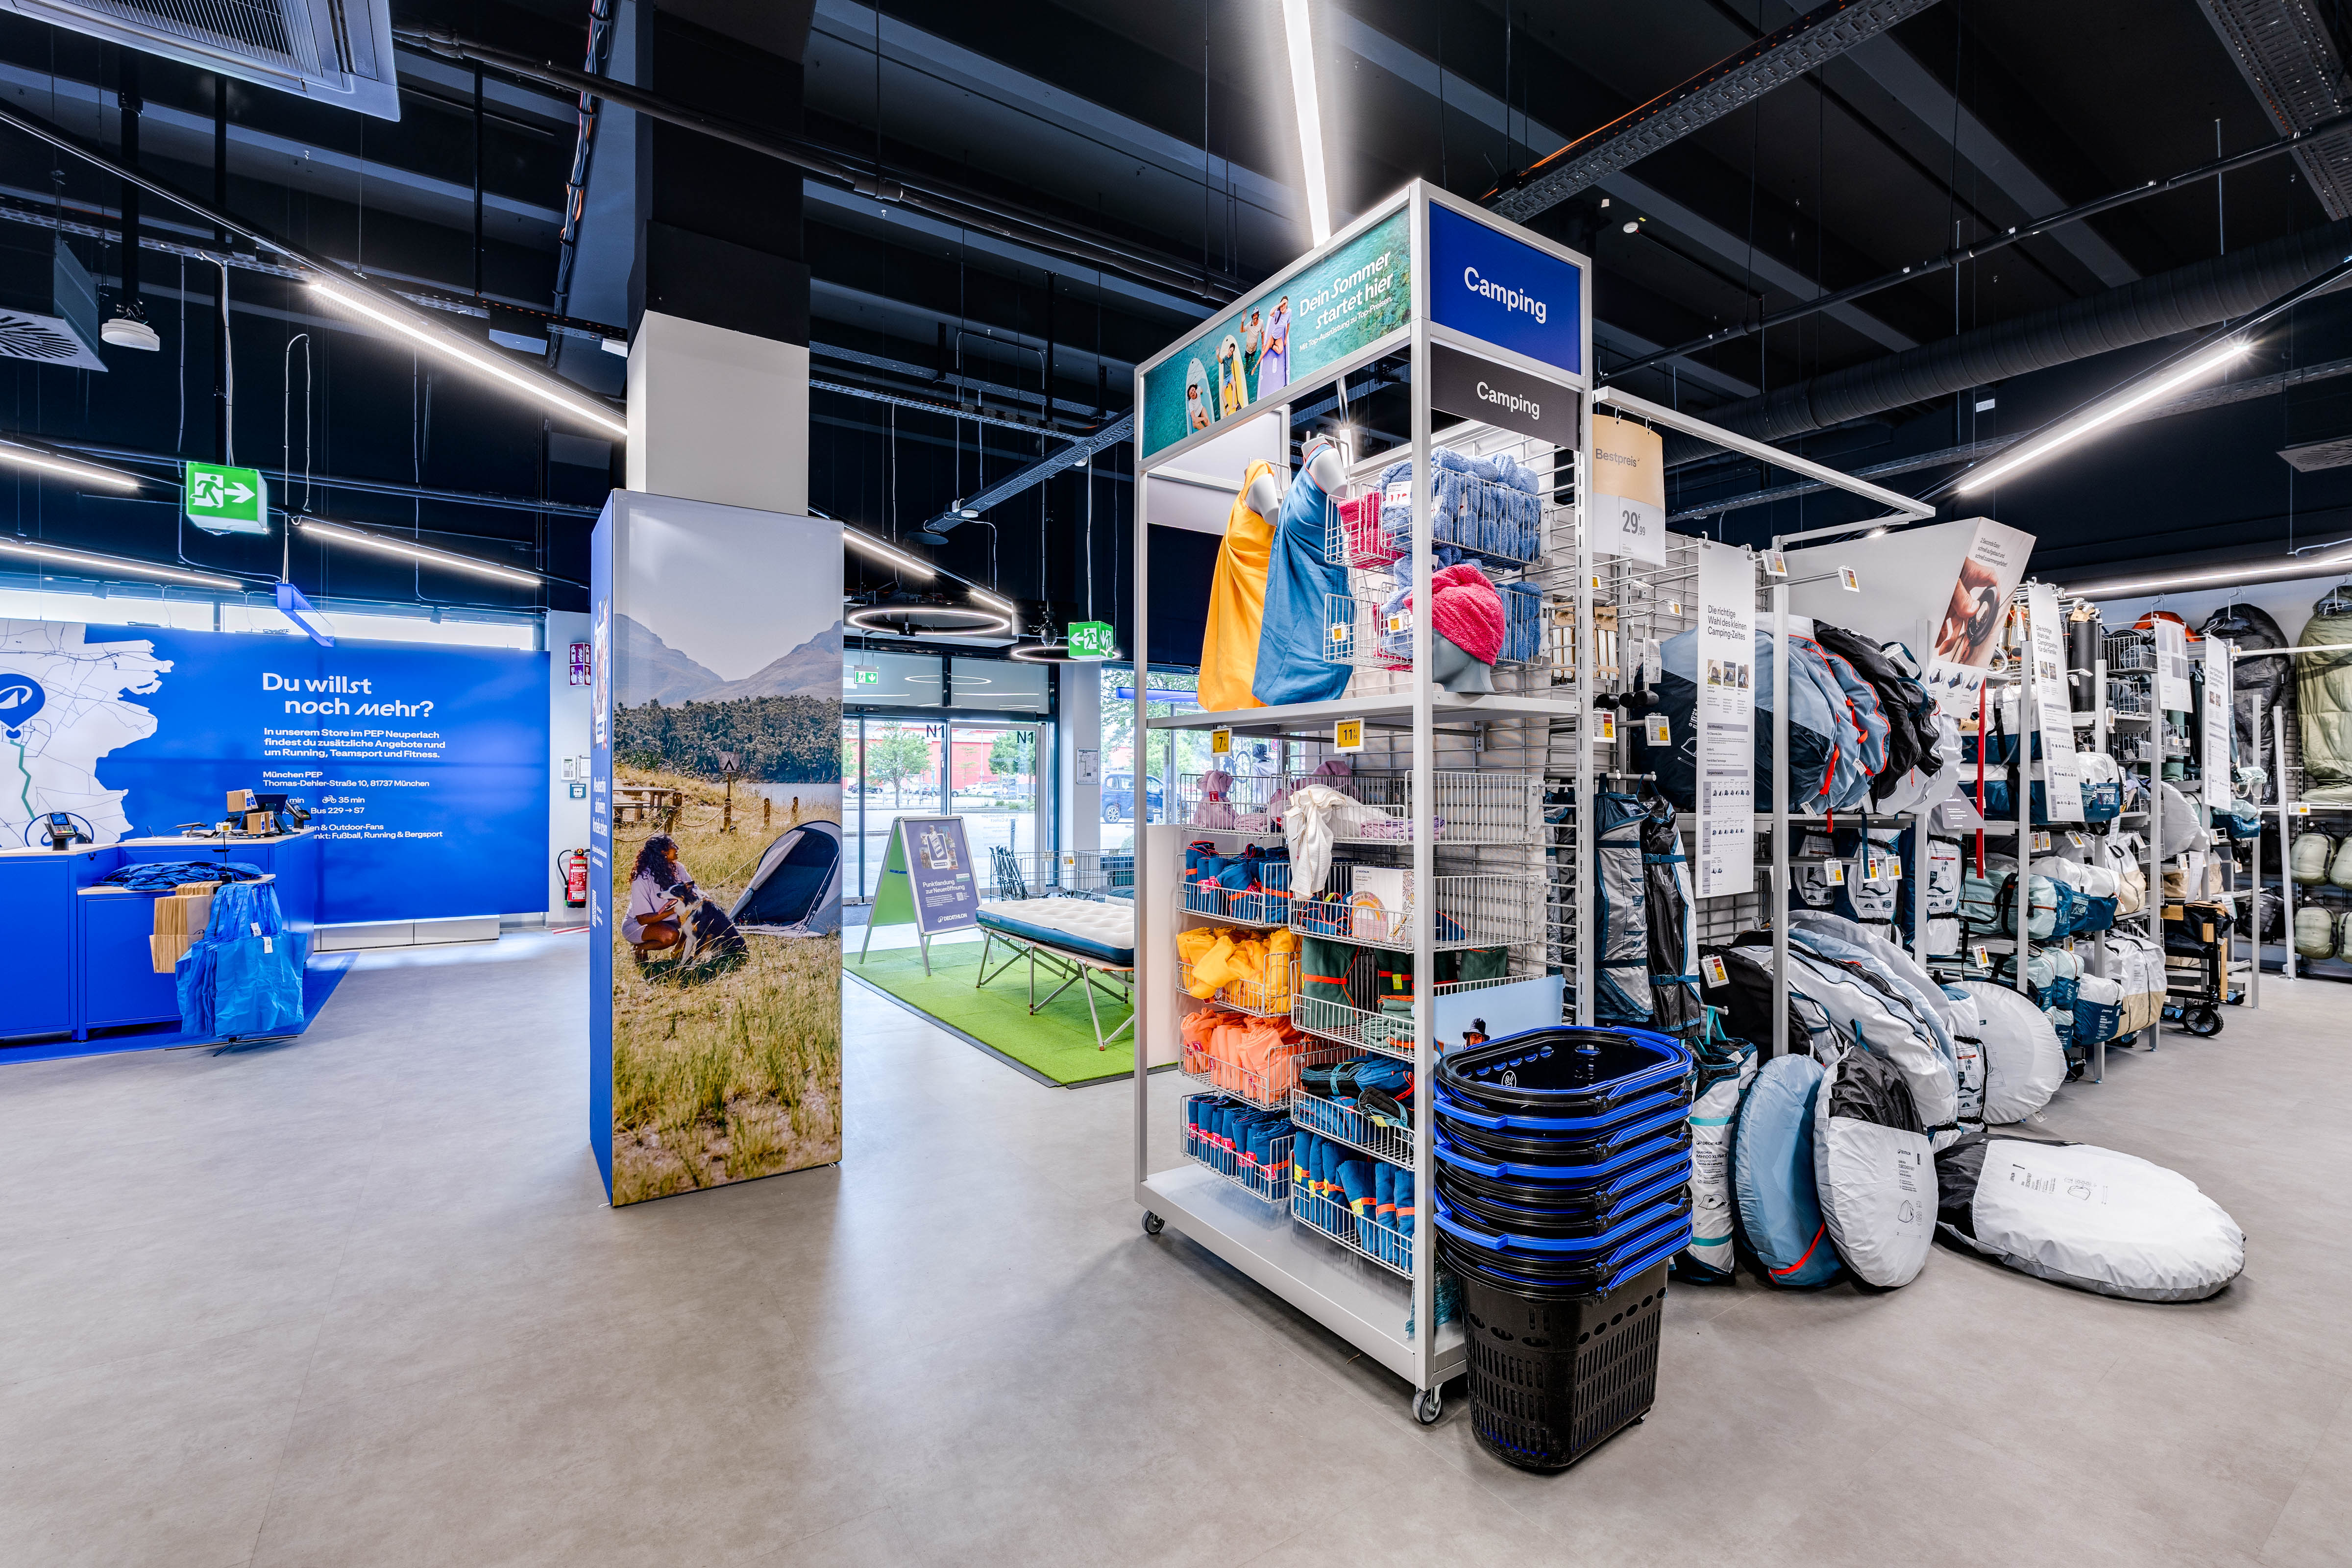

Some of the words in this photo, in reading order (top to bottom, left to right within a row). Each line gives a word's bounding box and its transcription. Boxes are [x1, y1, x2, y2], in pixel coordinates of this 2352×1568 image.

[1299, 289, 1329, 318] Dein
[1331, 251, 1391, 299] Sommer
[1316, 289, 1363, 330] startet
[1365, 273, 1394, 302] hier
[1464, 267, 1546, 324] Camping
[1299, 343, 1308, 352] Mit
[1308, 319, 1350, 345] Top-Ausrüstung
[1350, 316, 1357, 324] zu
[1357, 296, 1393, 320] Top-Preisen.
[1476, 381, 1540, 420] Camping
[1595, 448, 1637, 467] Bestpreis
[1622, 510, 1638, 534] 29
[1708, 605, 1717, 614] Die
[1717, 607, 1736, 619] richtige
[1708, 615, 1721, 626] Wahl
[1722, 618, 1731, 627] des
[1731, 619, 1747, 631] kleinen
[1708, 626, 1745, 640] Camping-Zeltes
[262, 672, 300, 692] Du
[304, 675, 372, 695] willst
[285, 697, 350, 715] noch
[354, 700, 434, 717] mehr?
[264, 727, 274, 735] In
[321, 729, 349, 737] Store
[385, 730, 440, 739] Neuperlach
[926, 724, 945, 738] N1
[1017, 731, 1034, 744] N1
[1344, 729, 1352, 740] 11
[317, 739, 373, 747] zusätzliche
[374, 740, 423, 749] Angebote
[1219, 736, 1223, 749] 7
[282, 749, 328, 759] Running,
[329, 749, 383, 759] Teamsport
[922, 880, 955, 888] Punktlandung
[933, 885, 965, 893] Neueröffnung
[943, 913, 968, 921] DECATHLON
